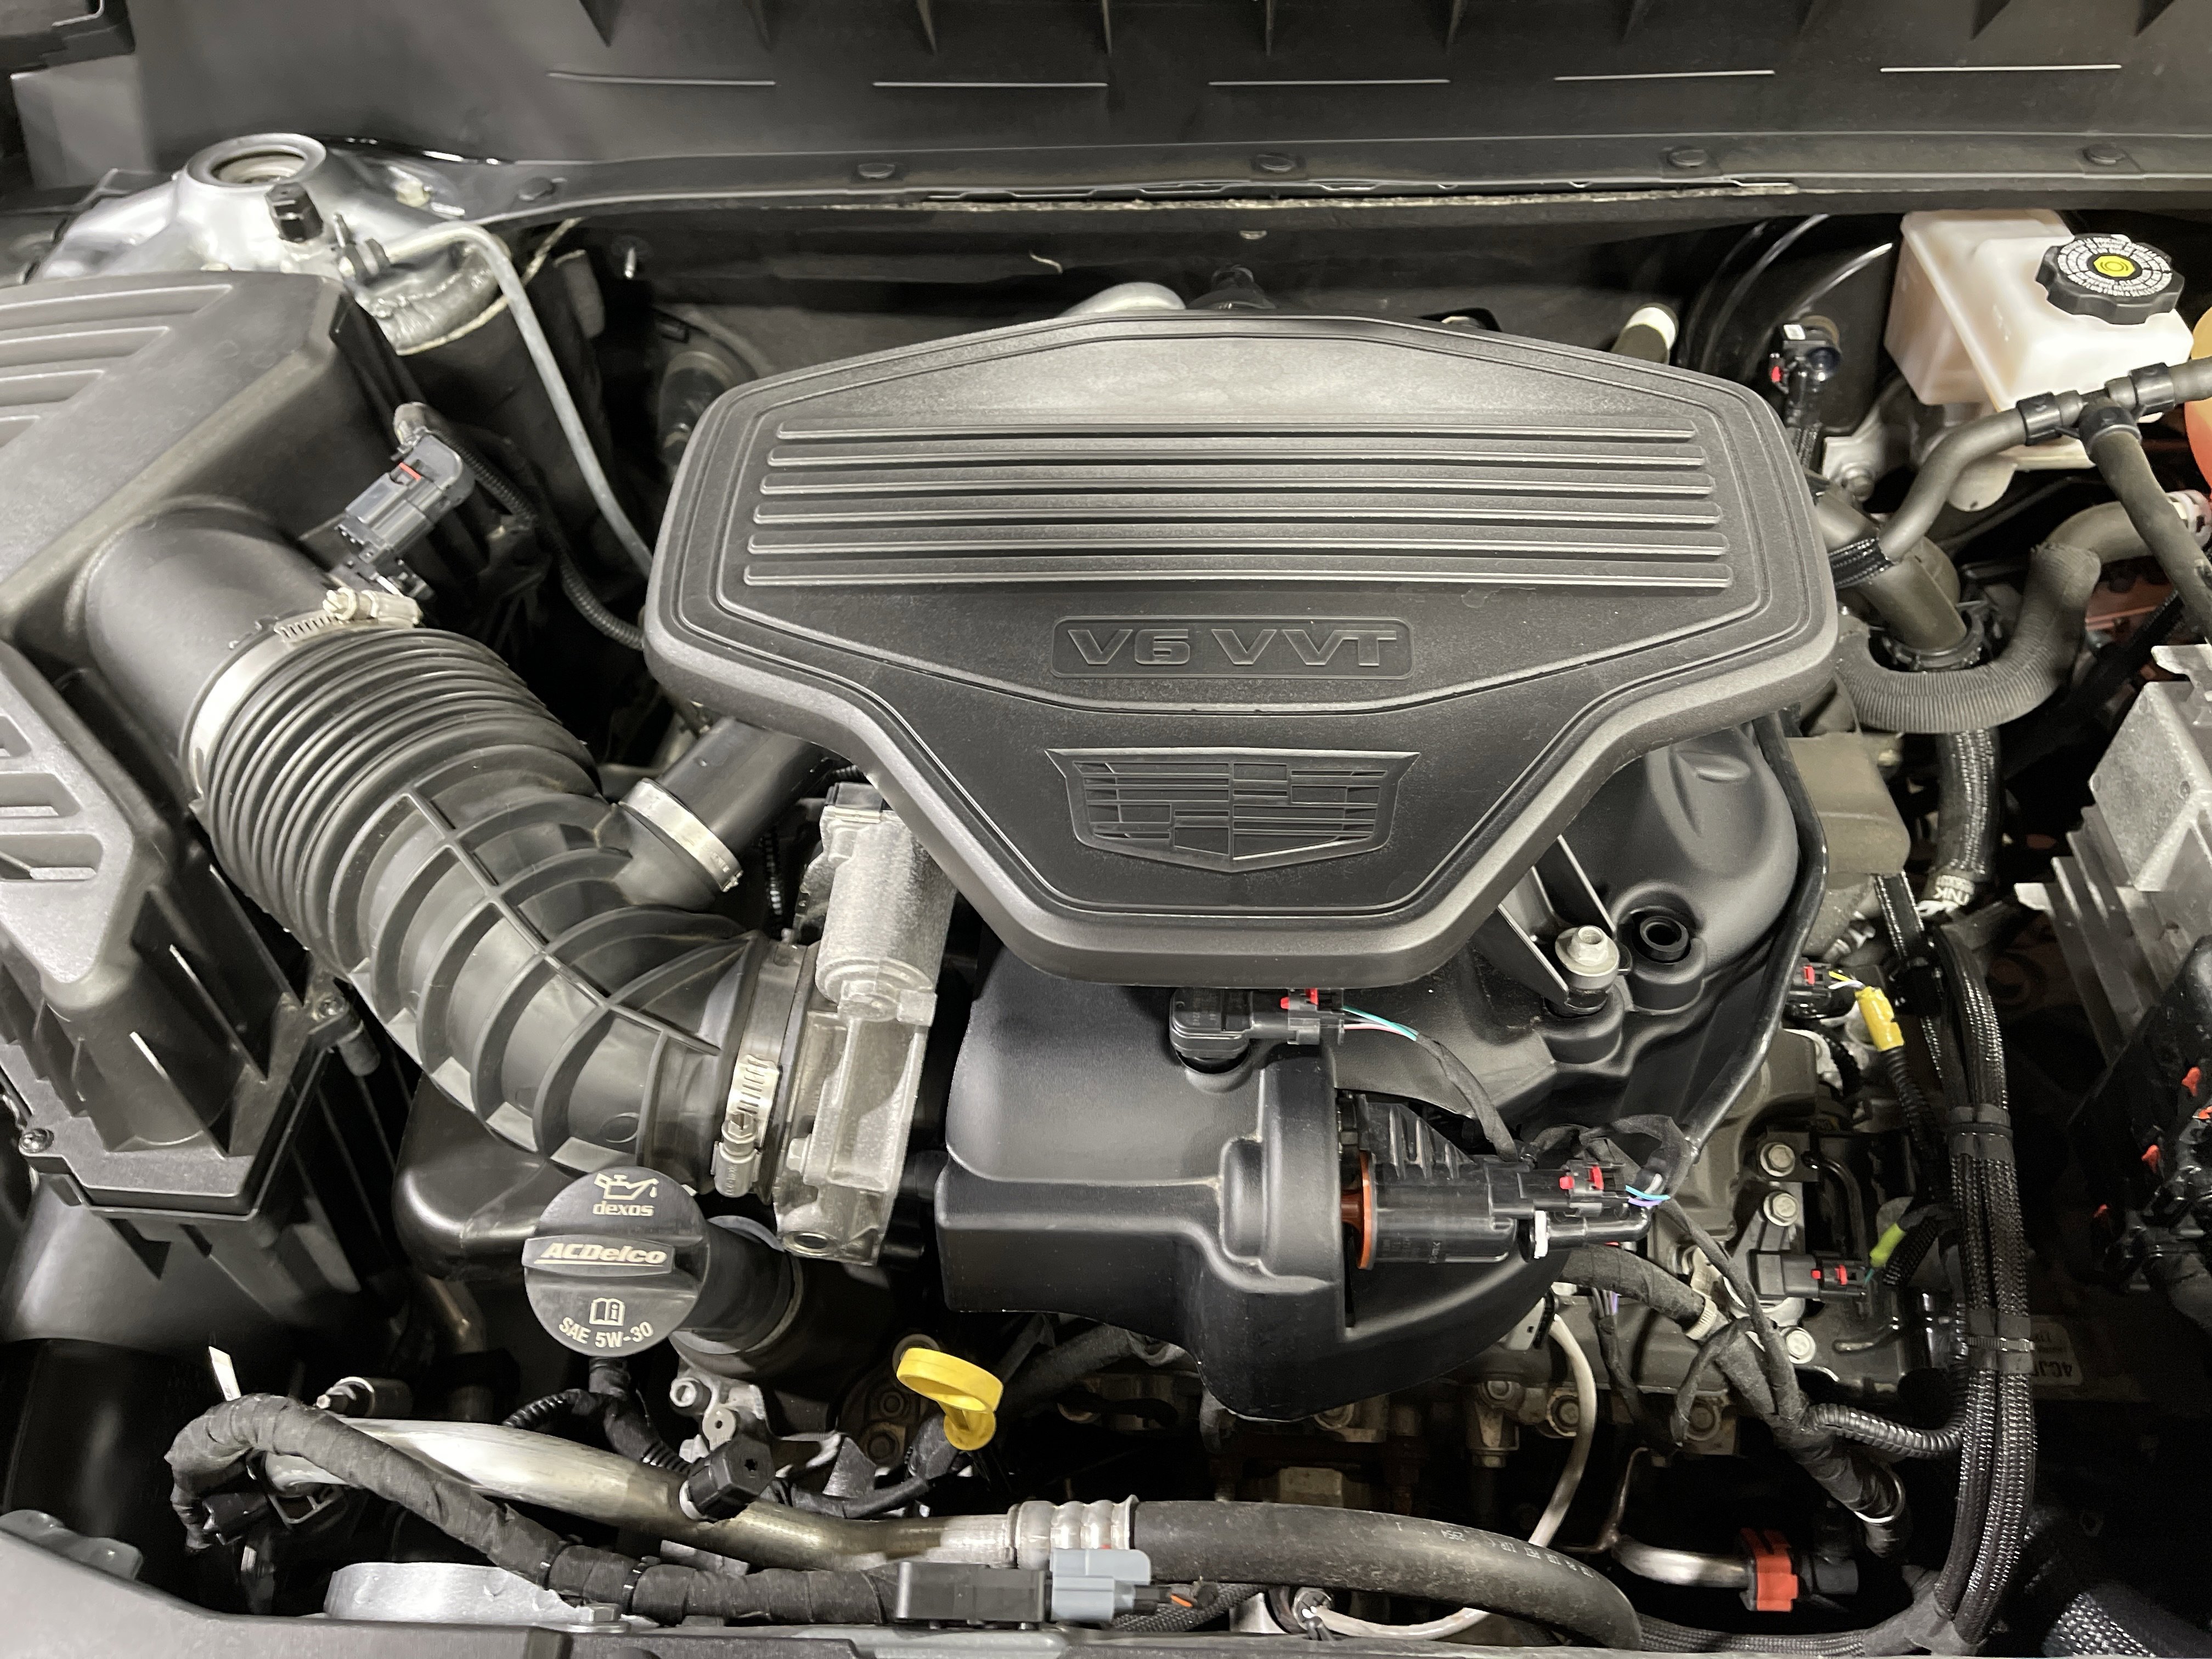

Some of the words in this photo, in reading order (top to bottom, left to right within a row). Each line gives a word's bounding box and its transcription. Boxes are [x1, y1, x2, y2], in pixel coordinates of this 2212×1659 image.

[1068, 629, 1190, 665] V6
[1211, 629, 1397, 666] VVT
[592, 1201, 654, 1217] dexos
[540, 1242, 667, 1264] ACDelco
[558, 1316, 591, 1344] SAE
[595, 1321, 654, 1348] 5W-30
